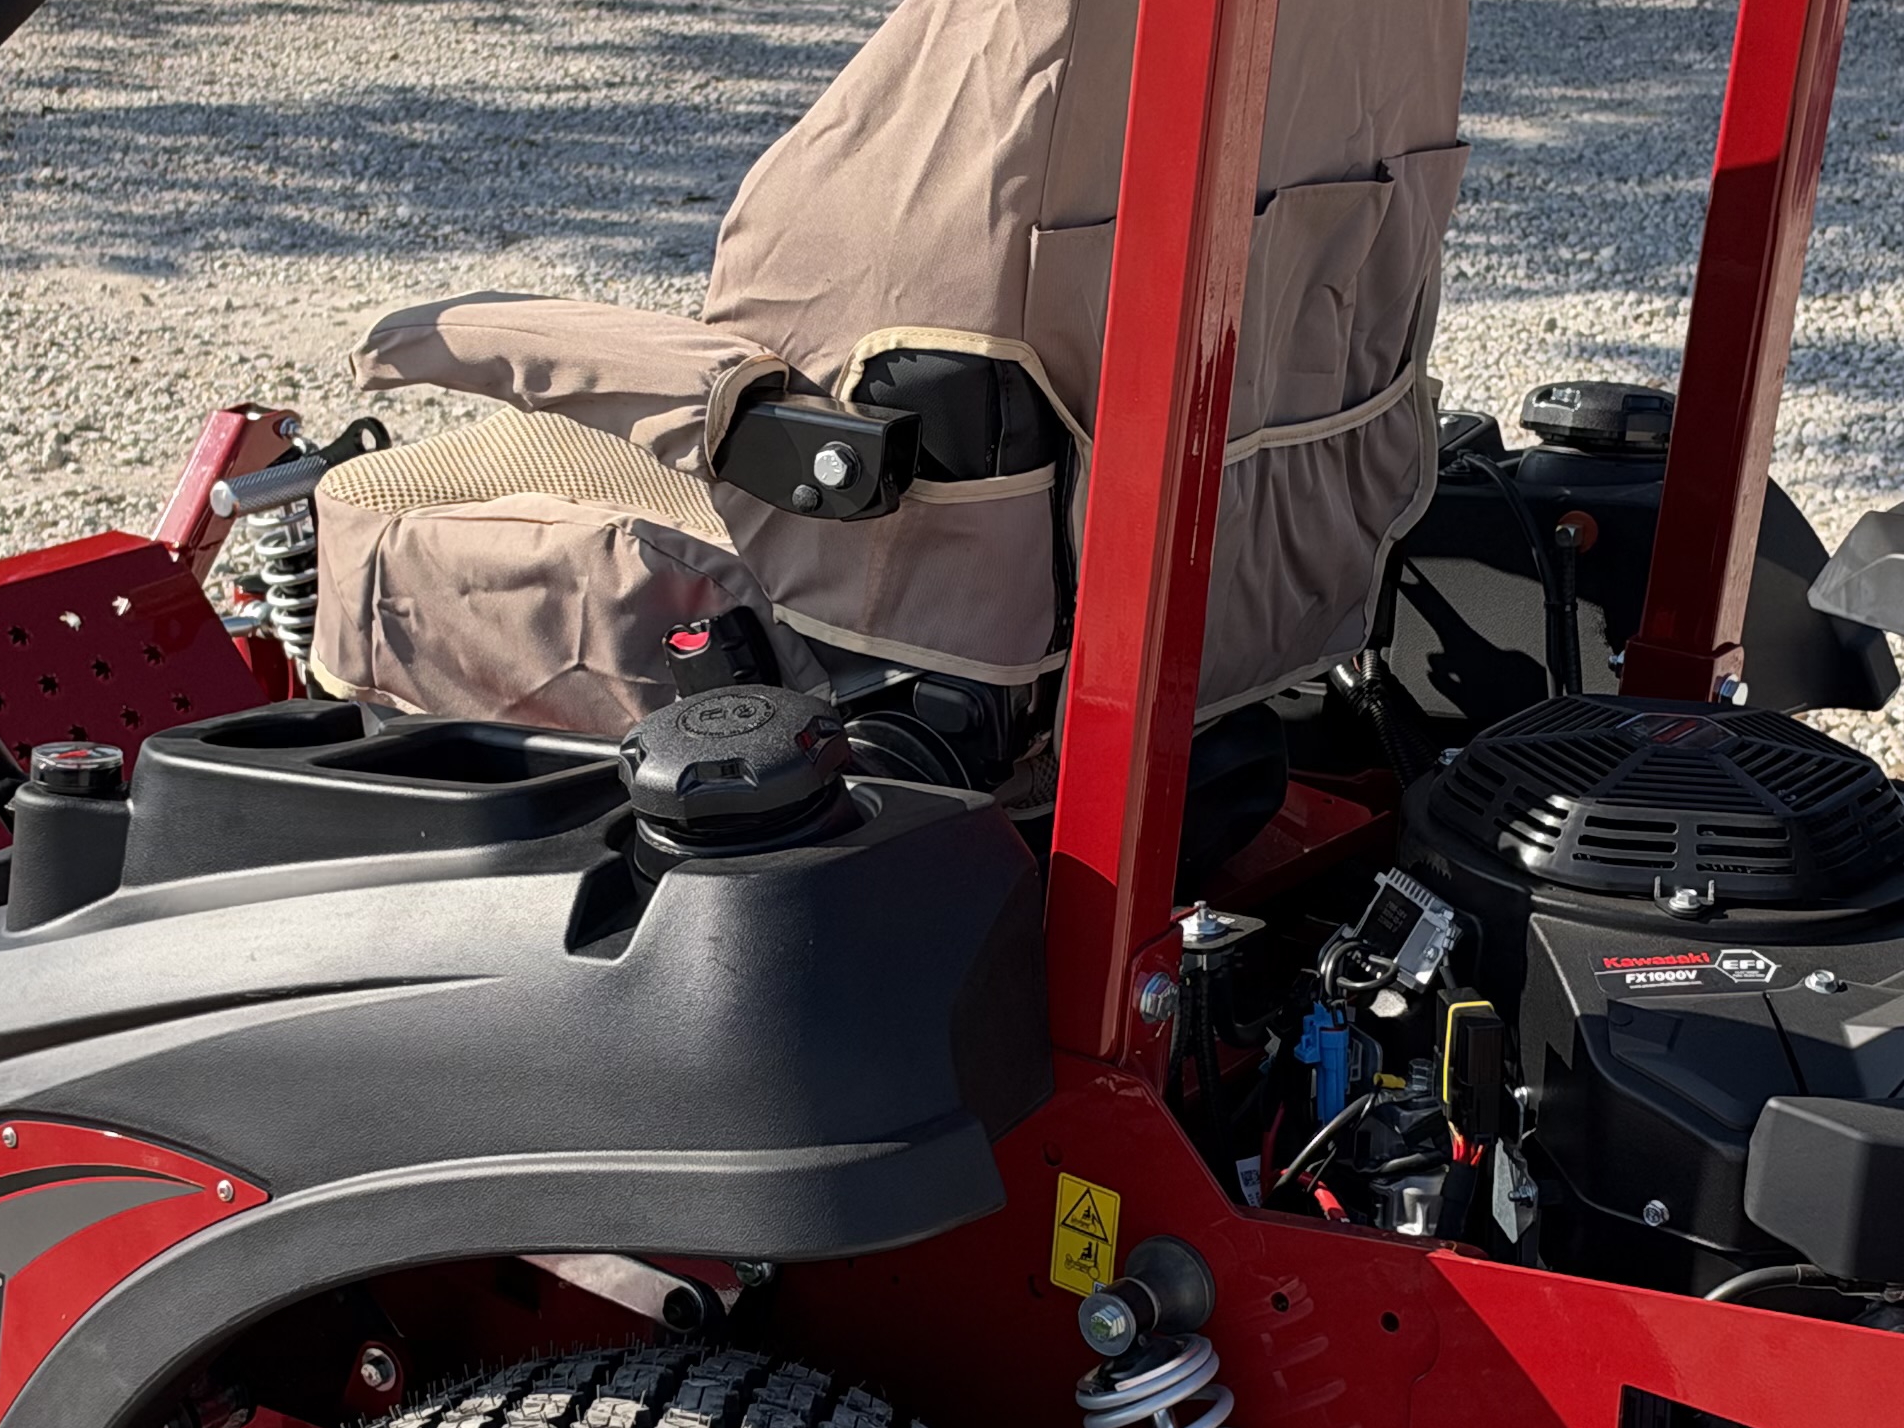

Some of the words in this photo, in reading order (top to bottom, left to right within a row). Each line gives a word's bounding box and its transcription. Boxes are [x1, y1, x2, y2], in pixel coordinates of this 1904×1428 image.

[1603, 952, 1710, 968] Kawasaki
[1722, 960, 1766, 970] EFI
[1625, 970, 1698, 984] FX1000V
